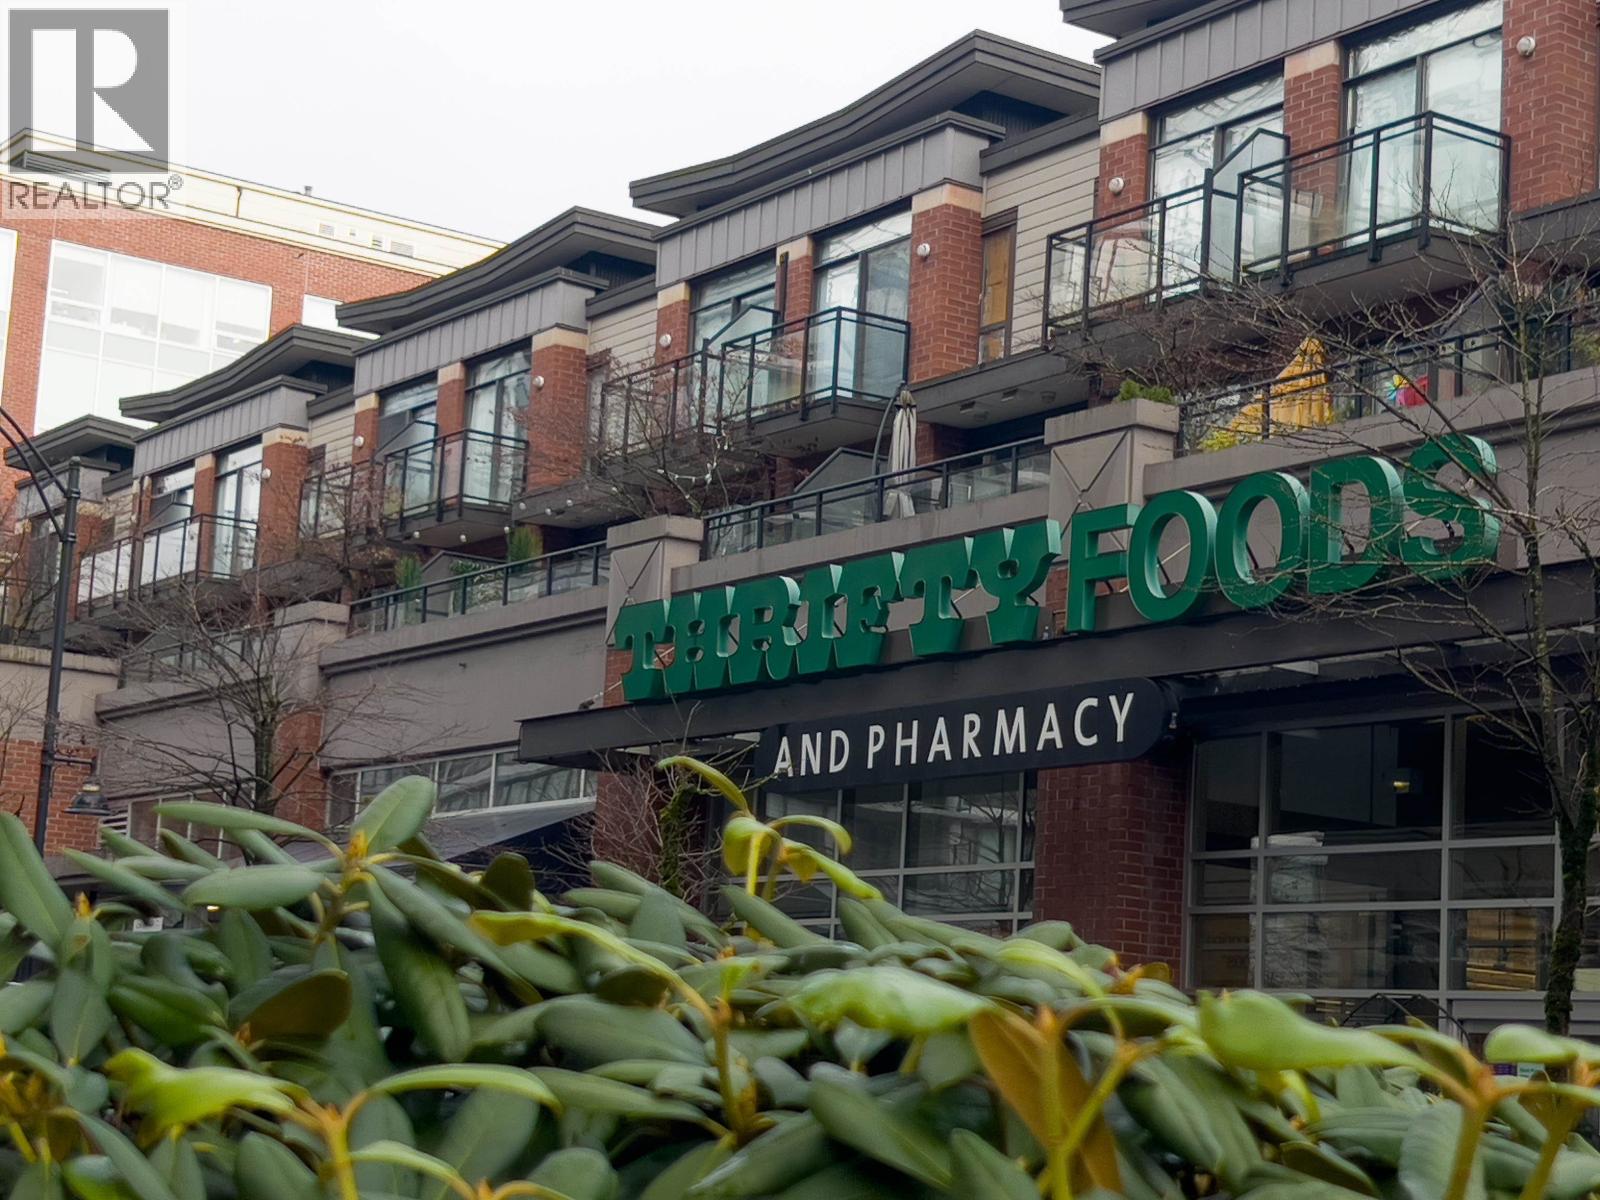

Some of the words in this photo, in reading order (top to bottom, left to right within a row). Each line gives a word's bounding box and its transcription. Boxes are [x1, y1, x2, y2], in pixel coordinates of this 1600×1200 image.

[614, 519, 1062, 702] THRIFTY
[1065, 434, 1500, 633] FOODS
[774, 729, 850, 777] AND
[866, 692, 1135, 769] PHARMACY
